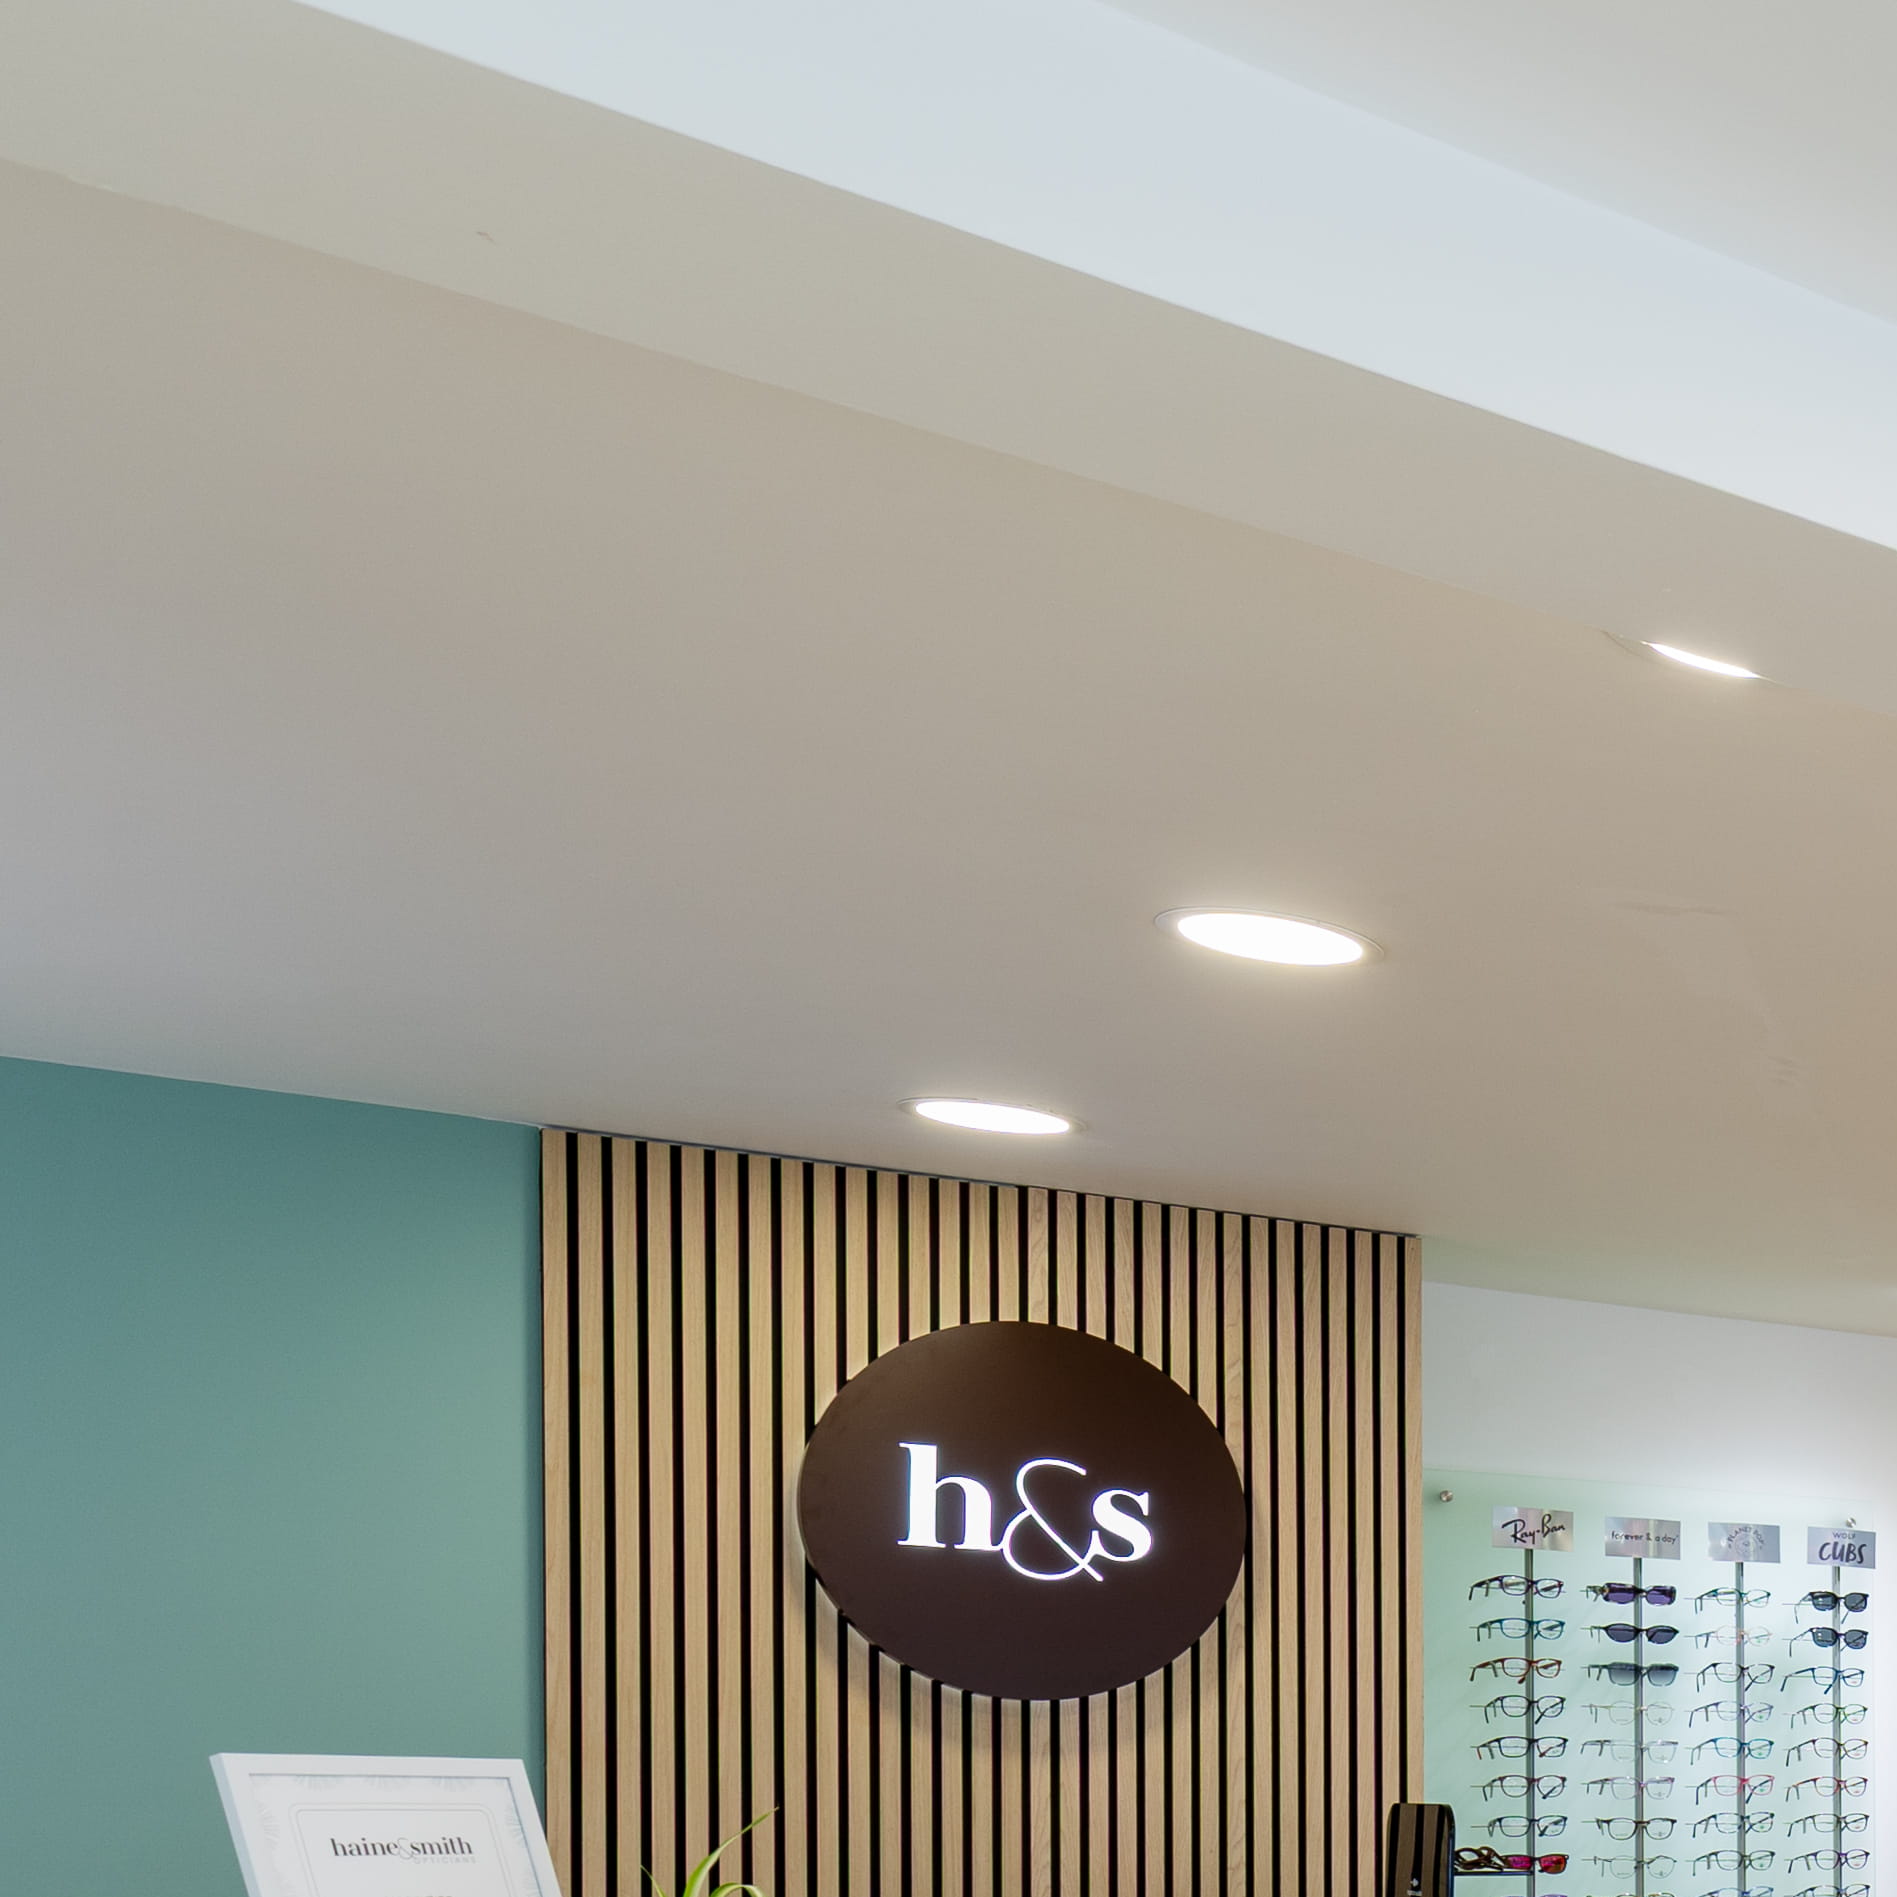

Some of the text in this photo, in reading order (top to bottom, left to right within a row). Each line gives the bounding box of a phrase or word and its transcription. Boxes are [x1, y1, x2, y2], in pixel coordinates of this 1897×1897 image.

[898, 1442, 1152, 1582] h&s
[1502, 1514, 1566, 1545] Ray-Ban
[1611, 1531, 1643, 1544] forever
[1646, 1532, 1653, 1542] &
[1832, 1531, 1856, 1540] WOLF
[1818, 1541, 1867, 1565] CUBS
[330, 1837, 474, 1860] haine&smith
